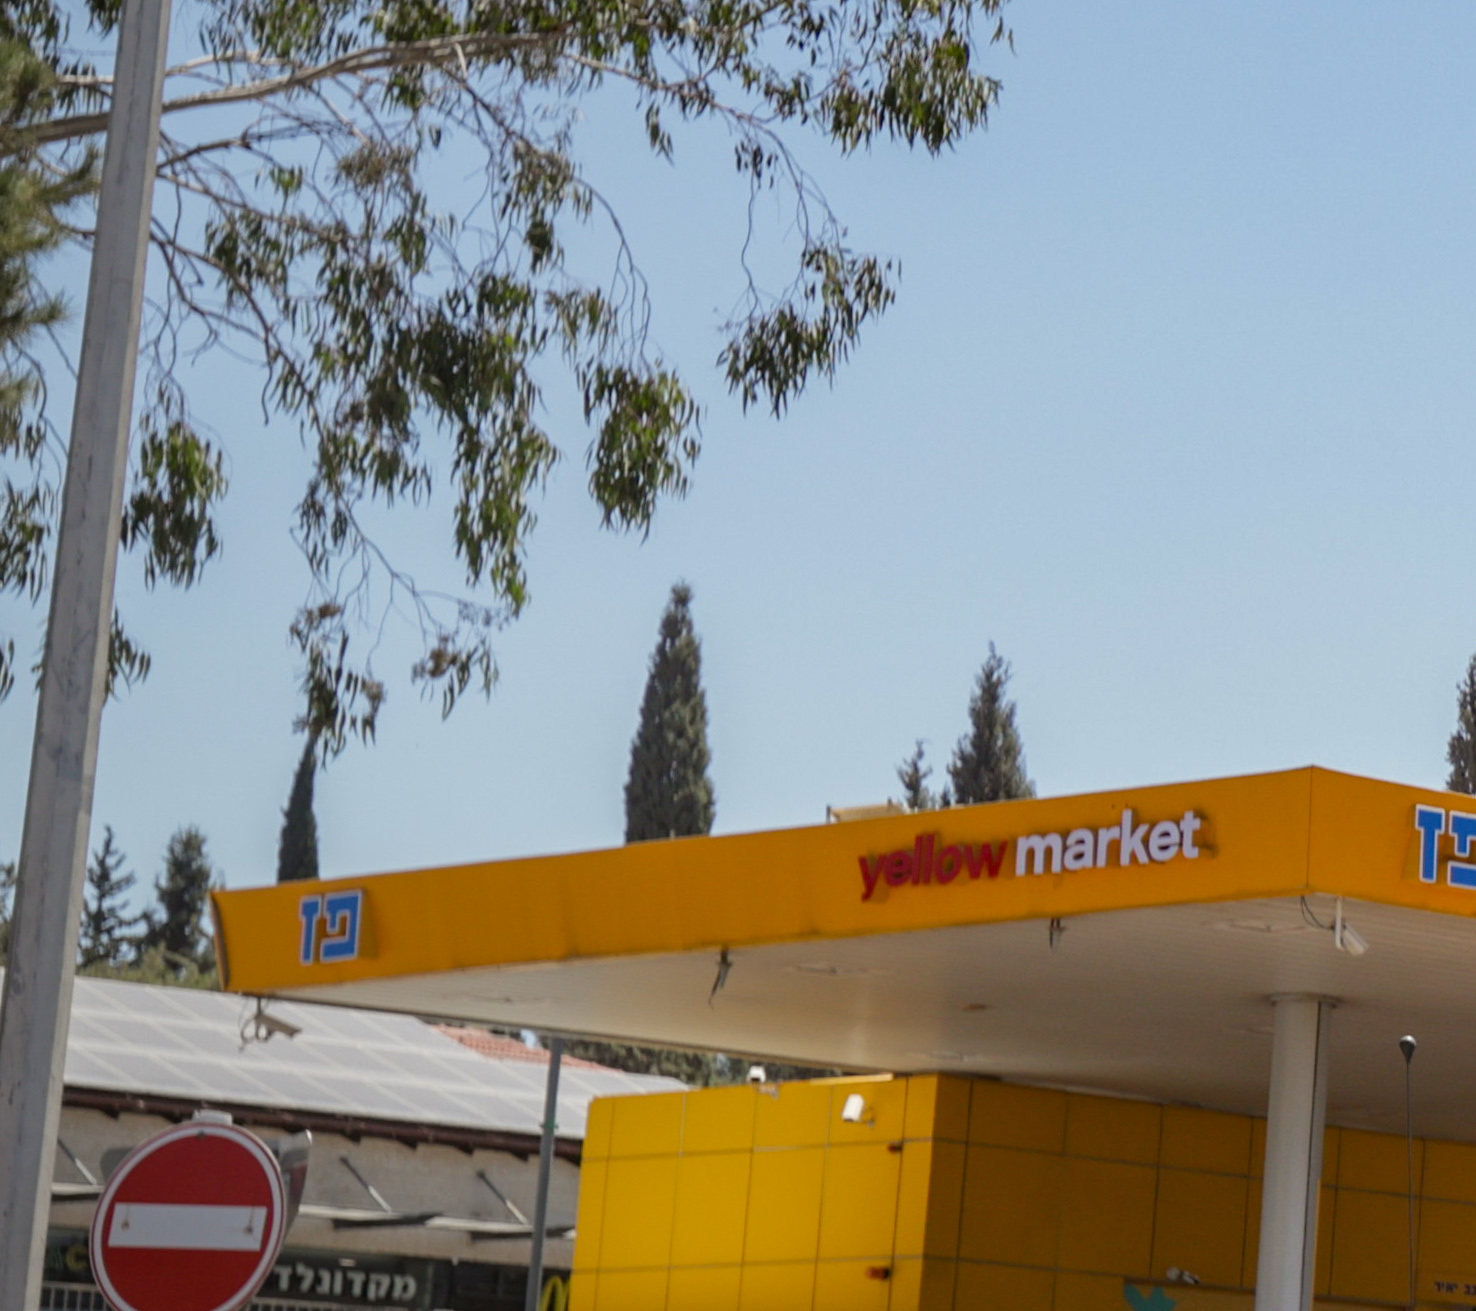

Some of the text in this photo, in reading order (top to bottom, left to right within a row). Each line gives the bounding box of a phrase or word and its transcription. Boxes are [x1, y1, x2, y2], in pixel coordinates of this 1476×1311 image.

[858, 809, 1201, 903] yellow market
[299, 888, 363, 966] פז
[273, 1260, 419, 1302] מקדונלד
